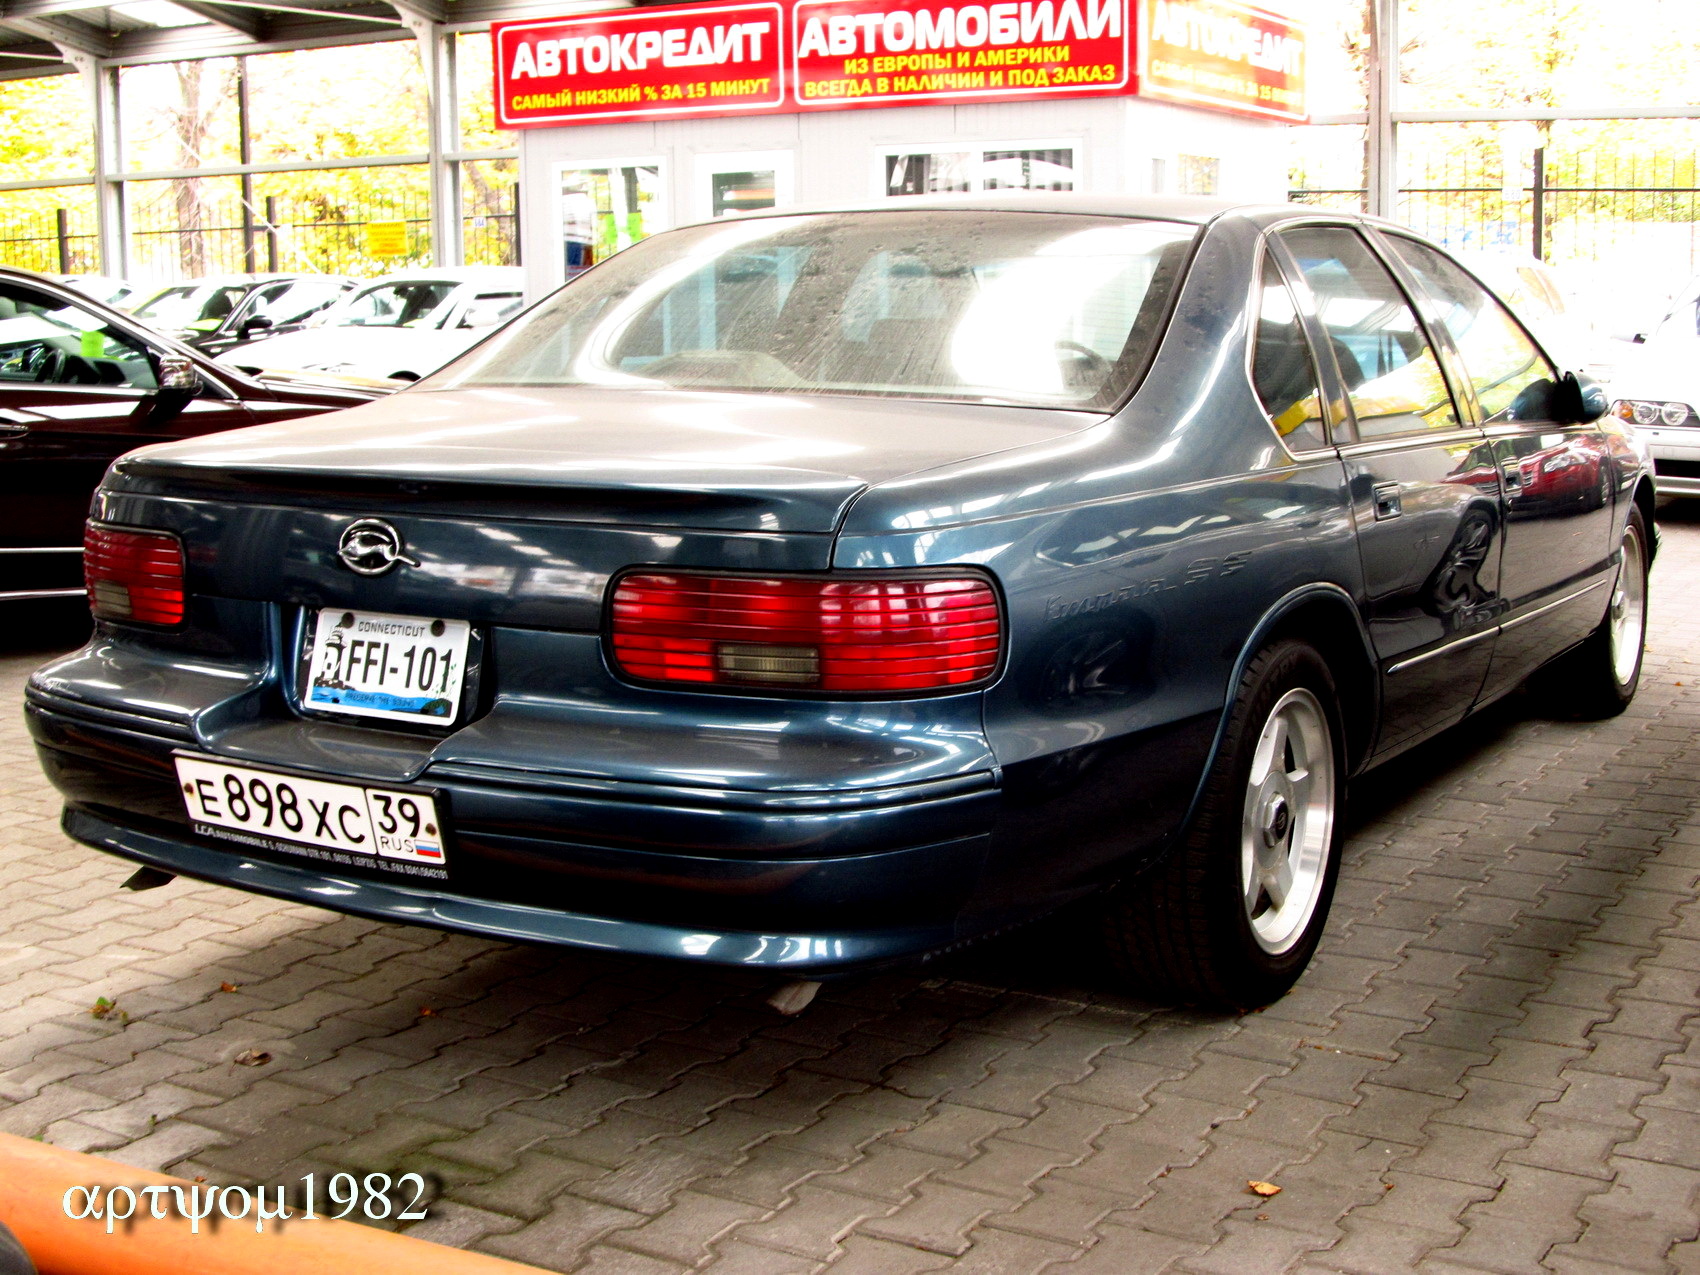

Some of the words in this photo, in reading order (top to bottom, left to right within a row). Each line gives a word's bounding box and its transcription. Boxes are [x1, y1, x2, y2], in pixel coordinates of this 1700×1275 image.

[798, 0, 1121, 58] АВТОМОБИЛИ
[510, 21, 770, 80] АВТОКРЕДИТ
[844, 57, 869, 75] ИЗ
[873, 52, 952, 73] ЕВРОПЫ
[956, 51, 971, 68] И
[974, 45, 1070, 67] АМЕРИКИ
[512, 88, 572, 111] САМЫЙ
[575, 83, 641, 106] НИЗКИЙ
[643, 85, 659, 101] %
[661, 84, 683, 100] ЗА
[686, 82, 707, 99] 15
[710, 77, 771, 97] МИНУТ
[804, 78, 873, 98] ВСЕГДА
[876, 77, 889, 94] В
[893, 70, 985, 92] НАЛИЧИИ
[989, 70, 1003, 87] И
[1008, 67, 1050, 87] ПОД
[1052, 64, 1116, 83] ЗАКАЗ
[358, 620, 425, 638] CONNECTICUT
[345, 639, 453, 693] FFI-101
[373, 794, 421, 839] 39
[379, 835, 415, 854] RUS
